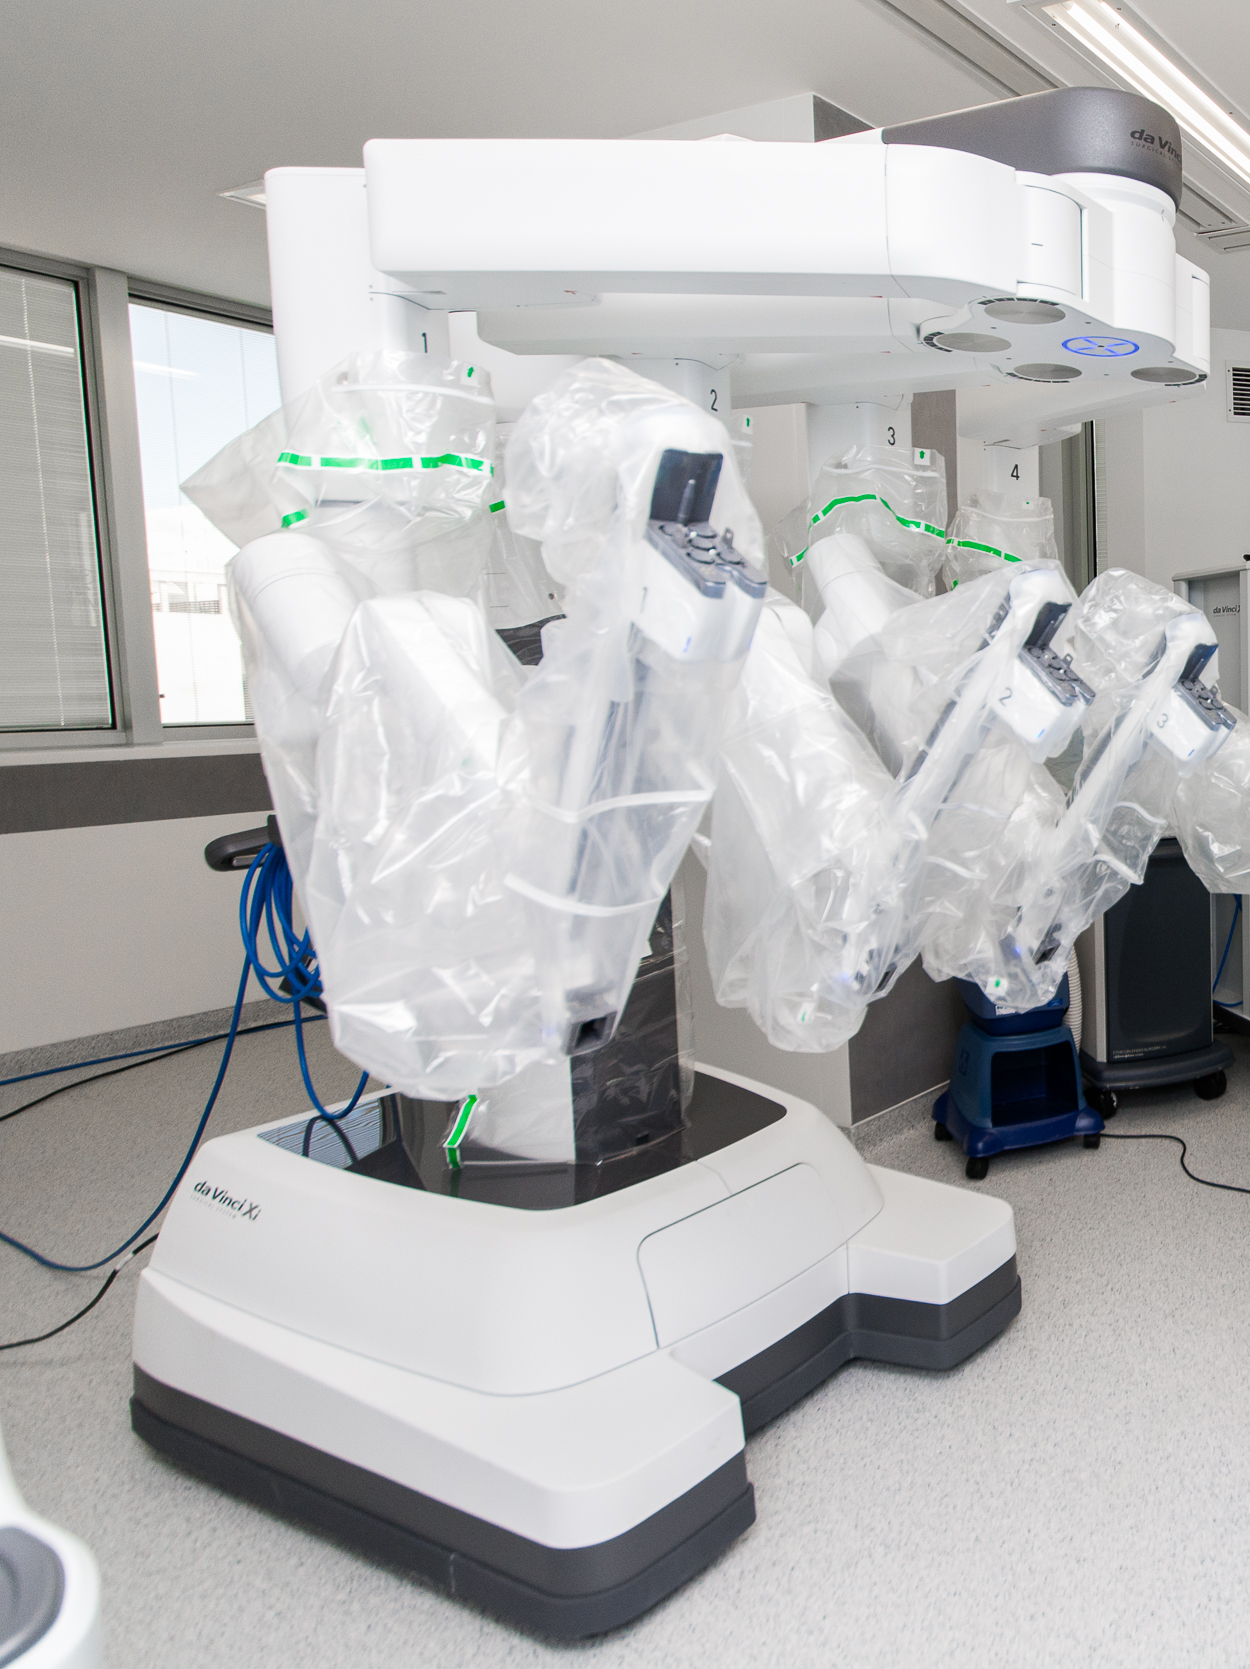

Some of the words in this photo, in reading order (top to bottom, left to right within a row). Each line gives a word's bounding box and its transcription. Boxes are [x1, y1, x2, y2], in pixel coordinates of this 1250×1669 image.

[1129, 128, 1155, 146] da
[421, 331, 428, 354] 1
[710, 388, 718, 412] 2
[887, 426, 896, 446] 3
[1010, 463, 1020, 481] 4
[998, 686, 1013, 707] 2
[1156, 712, 1169, 729] 3
[194, 1180, 212, 1197] da
[212, 1186, 248, 1212] Vinci
[241, 1201, 262, 1221] Xi
